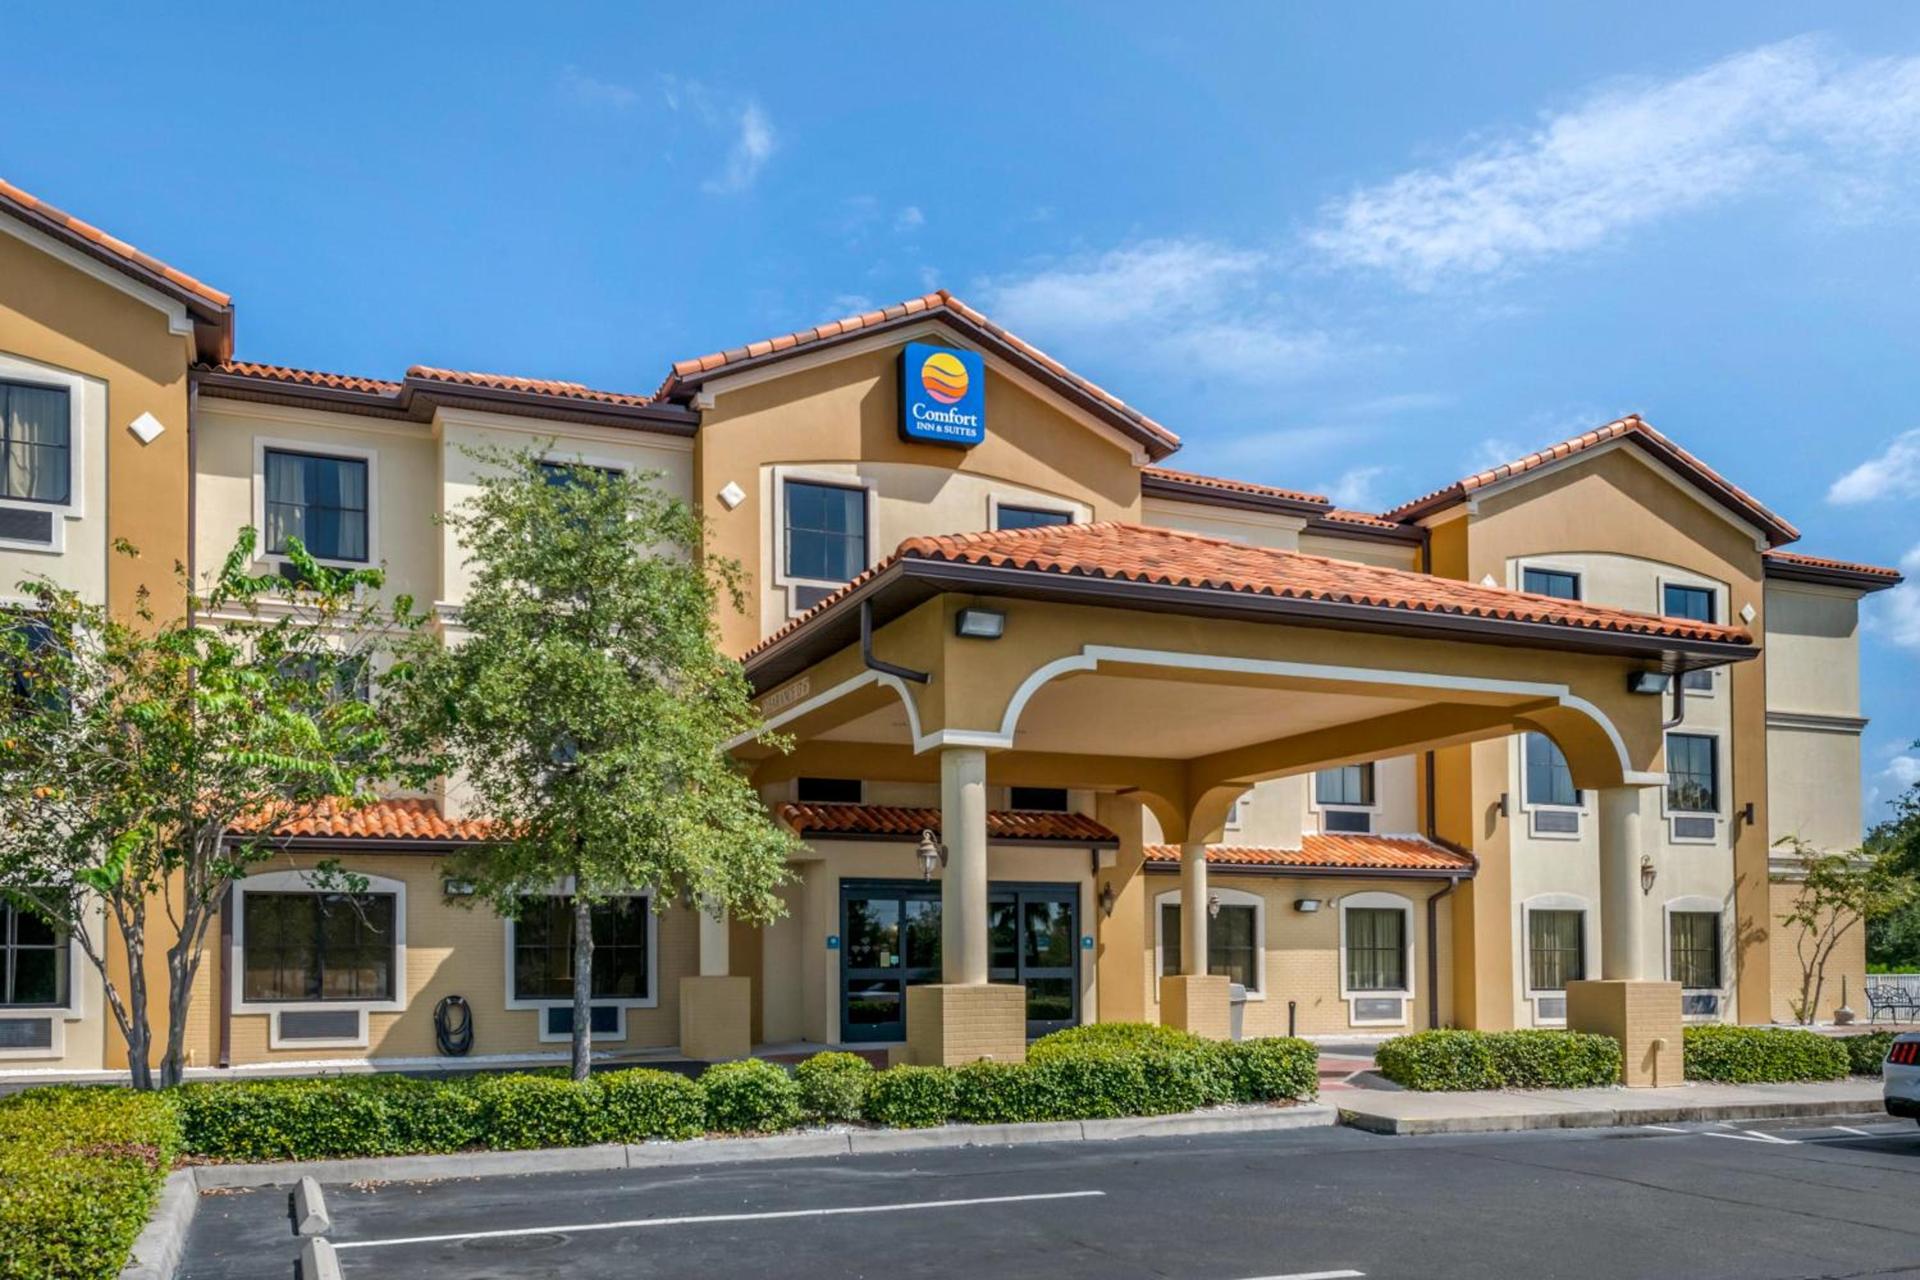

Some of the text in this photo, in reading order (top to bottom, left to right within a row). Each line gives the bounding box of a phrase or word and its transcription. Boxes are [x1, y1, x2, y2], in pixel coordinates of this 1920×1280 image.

[912, 402, 978, 426] Comfort
[916, 421, 935, 431] INN
[943, 426, 977, 437] SUITES
